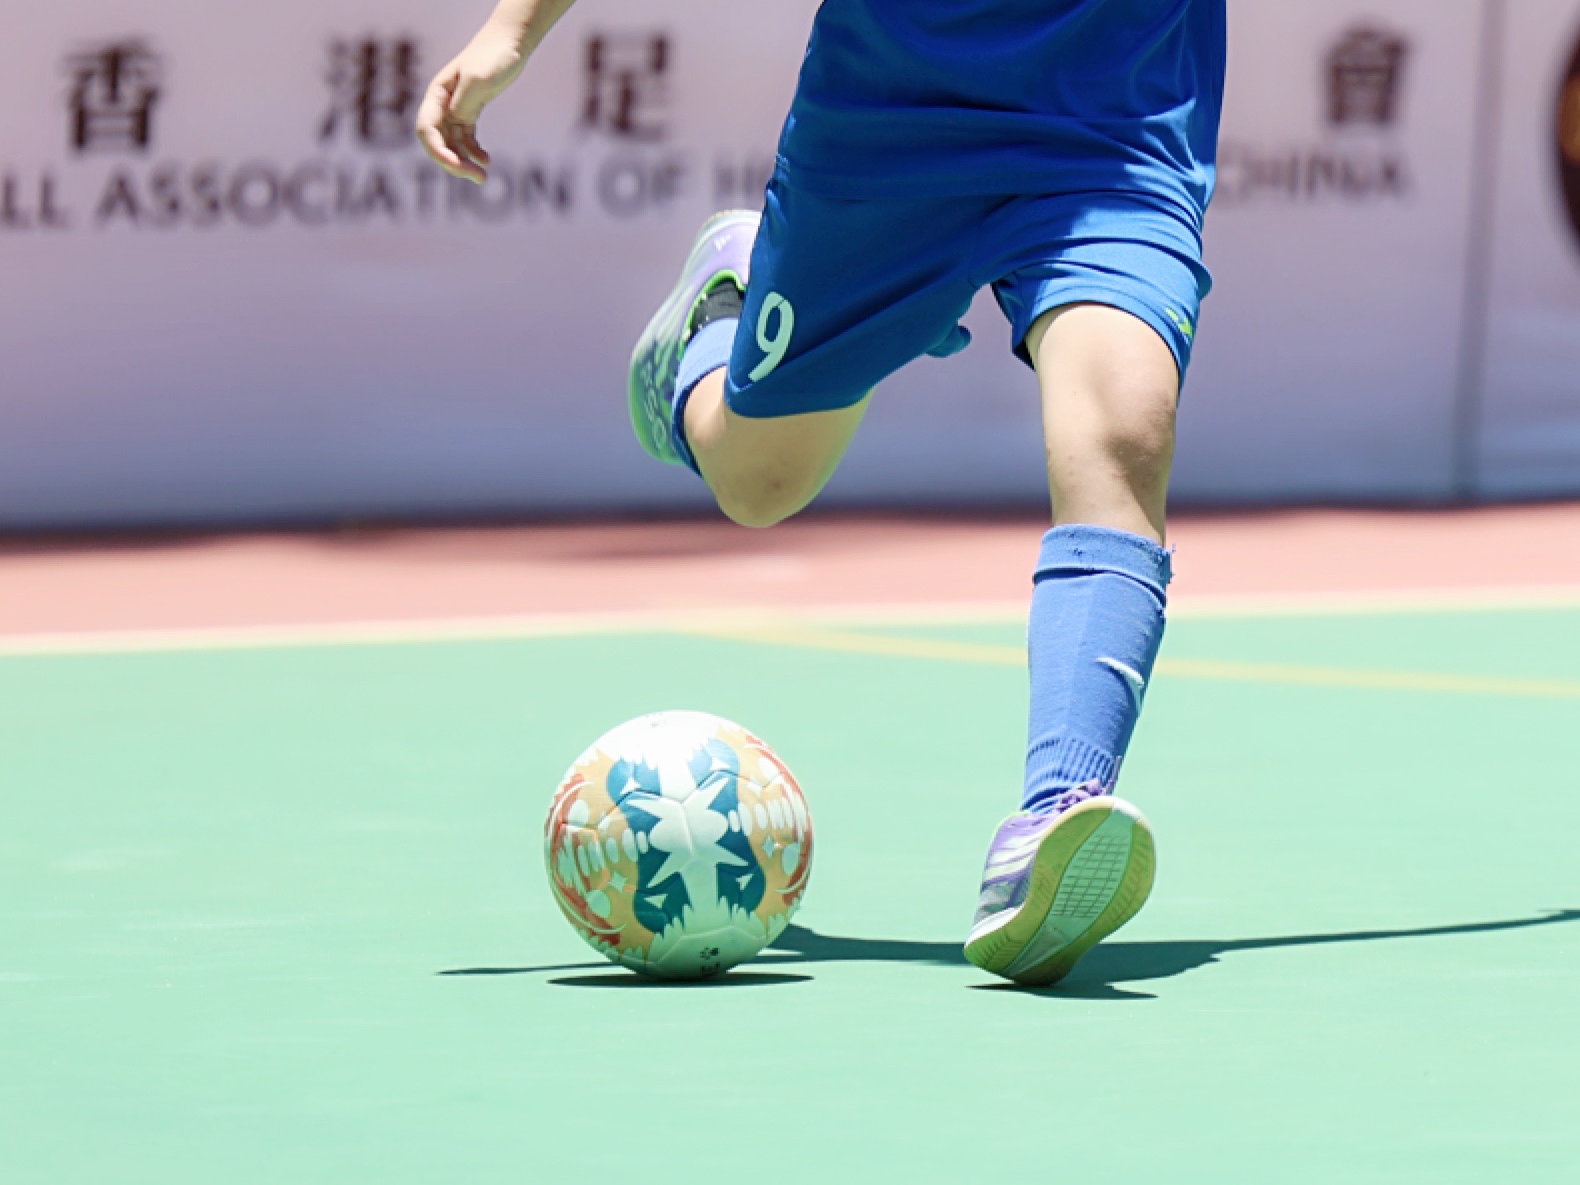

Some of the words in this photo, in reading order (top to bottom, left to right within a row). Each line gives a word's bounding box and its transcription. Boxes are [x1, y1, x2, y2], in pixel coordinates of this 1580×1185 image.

[96, 151, 575, 229] ASSOCIATION
[597, 146, 690, 213] OF
[749, 291, 794, 381] 9
